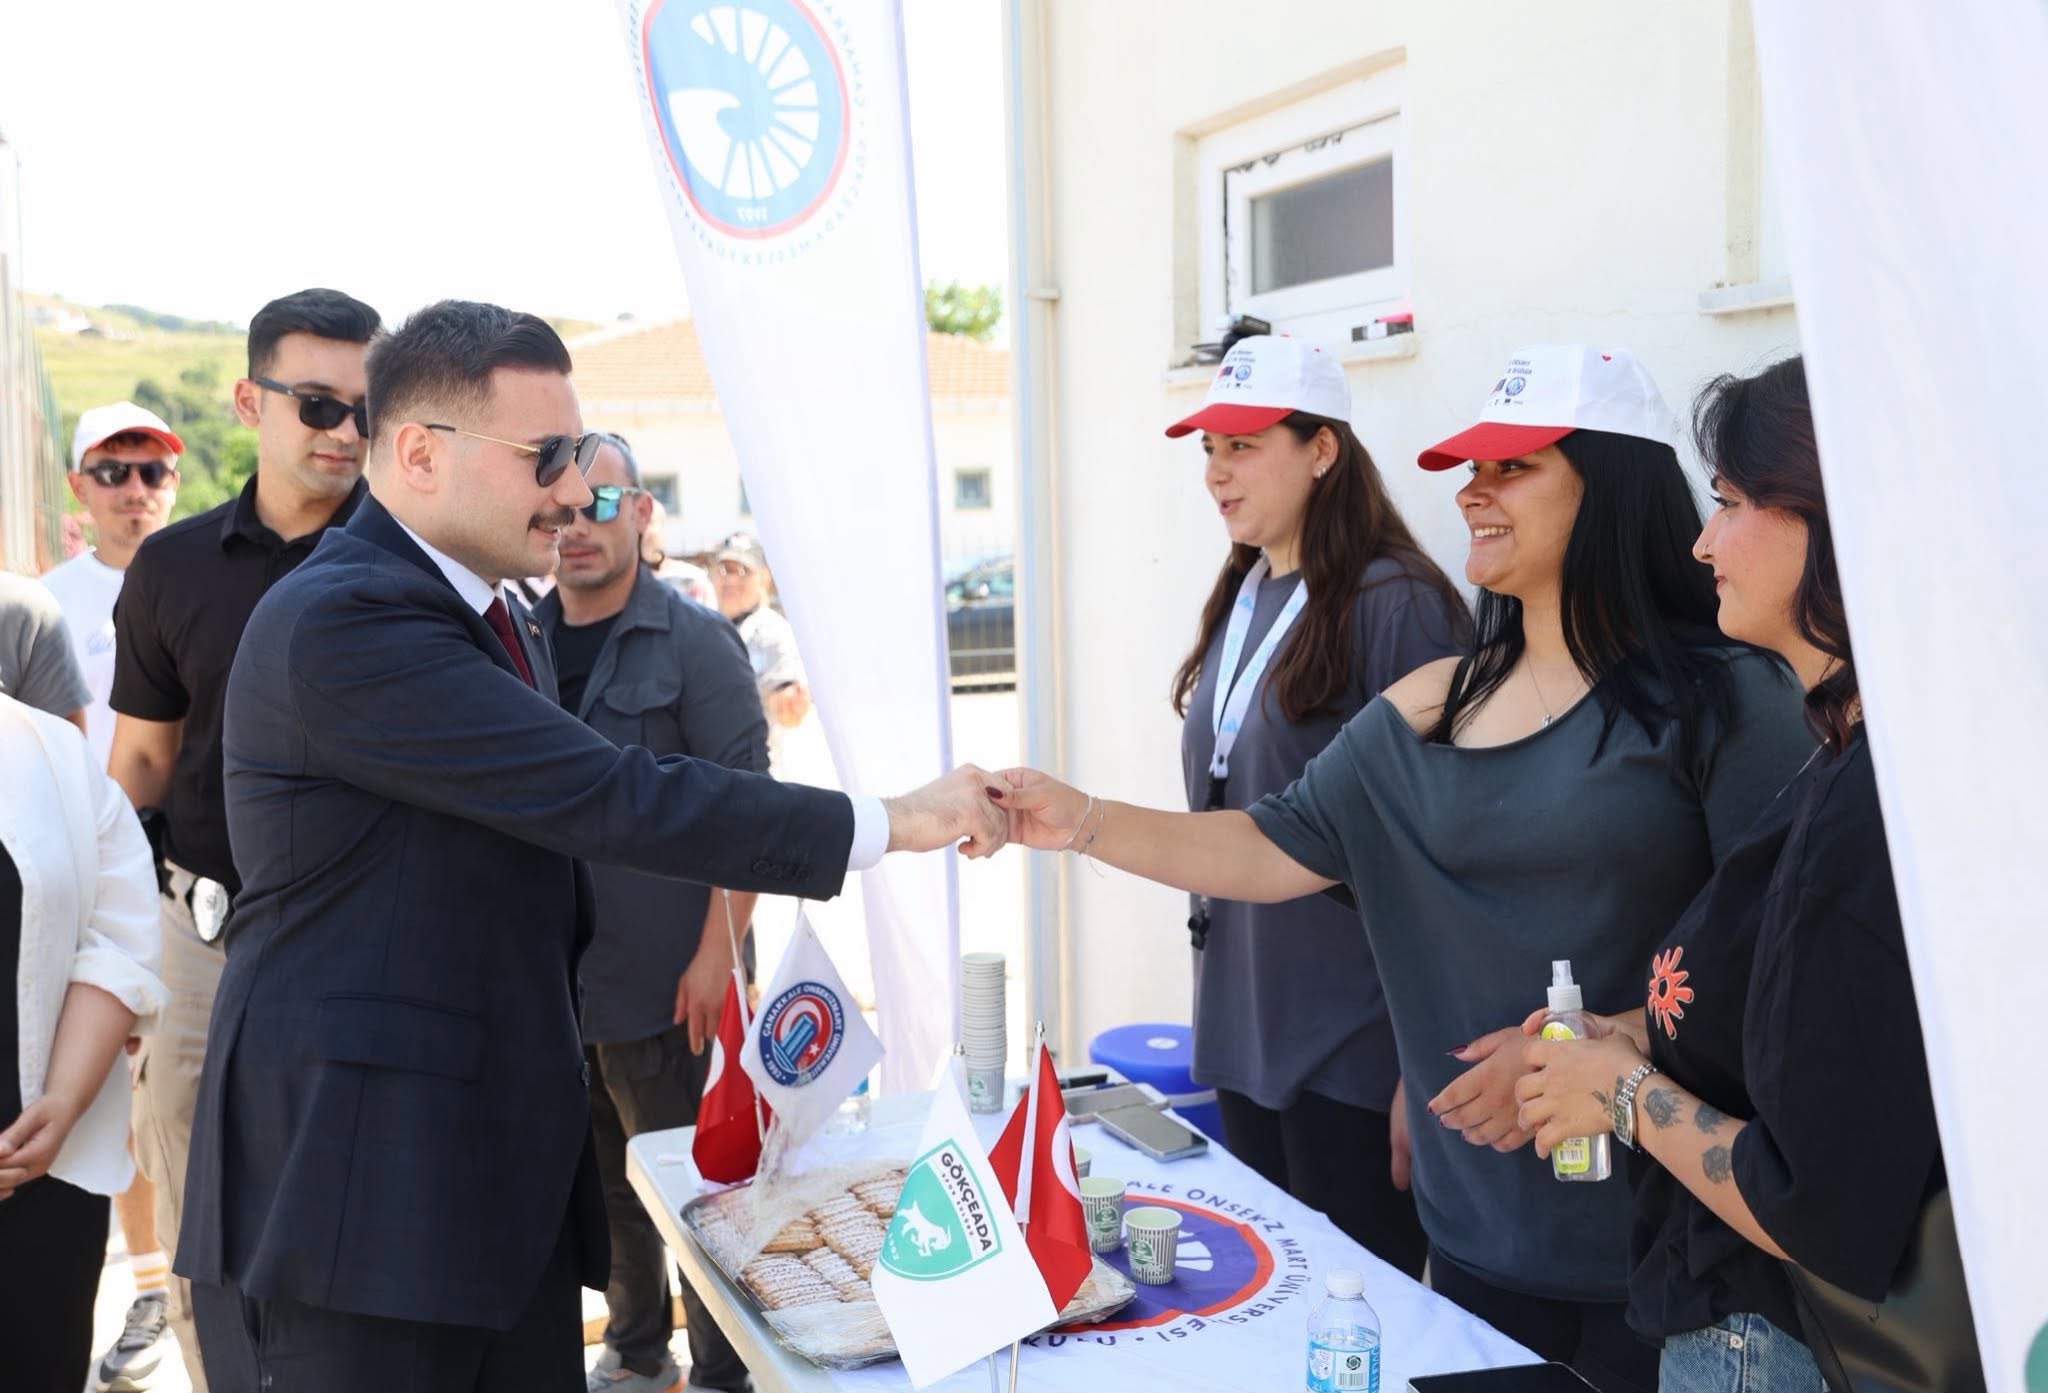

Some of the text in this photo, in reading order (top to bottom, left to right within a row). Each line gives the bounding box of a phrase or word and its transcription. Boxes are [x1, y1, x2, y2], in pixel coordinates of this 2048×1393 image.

[762, 986, 802, 1038] ÇANAKKALE
[941, 1152, 993, 1252] GÖKÇEADA
[1275, 1238, 1309, 1270] MART
